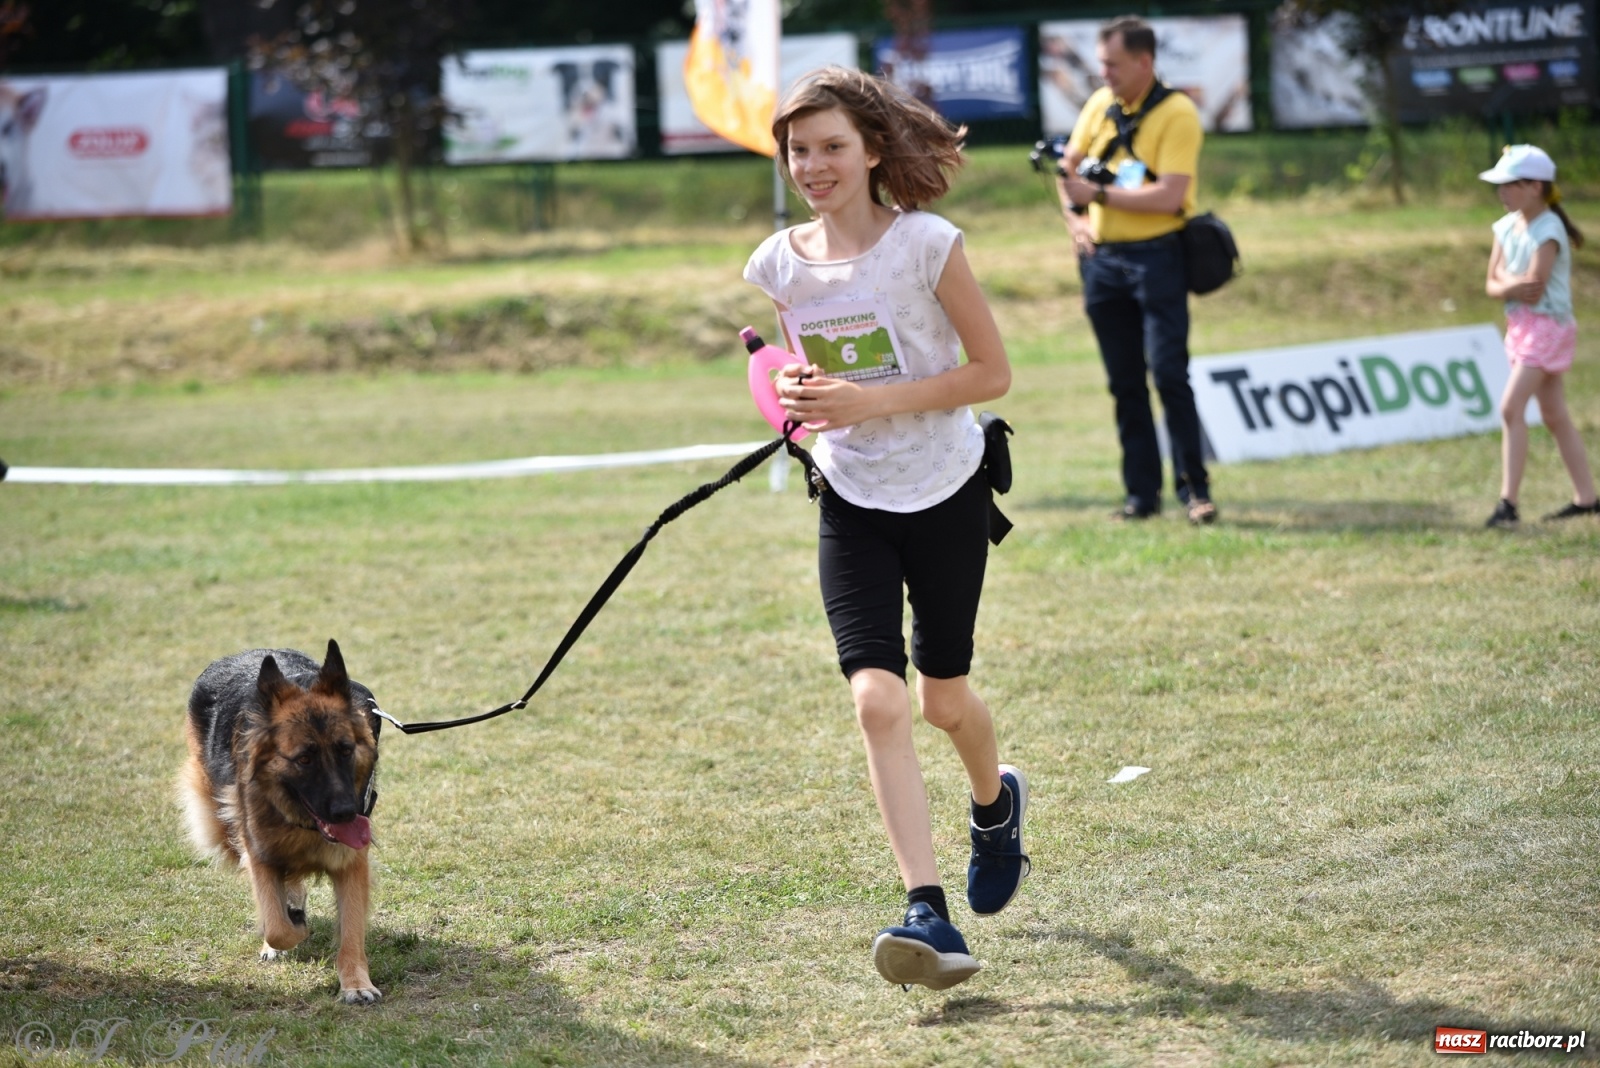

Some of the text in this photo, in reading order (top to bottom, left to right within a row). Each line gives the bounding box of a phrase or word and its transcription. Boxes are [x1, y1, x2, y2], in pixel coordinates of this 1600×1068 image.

[801, 312, 876, 331] DOGTREKKING
[841, 343, 858, 364] 6
[1209, 356, 1493, 433] TropiDog
